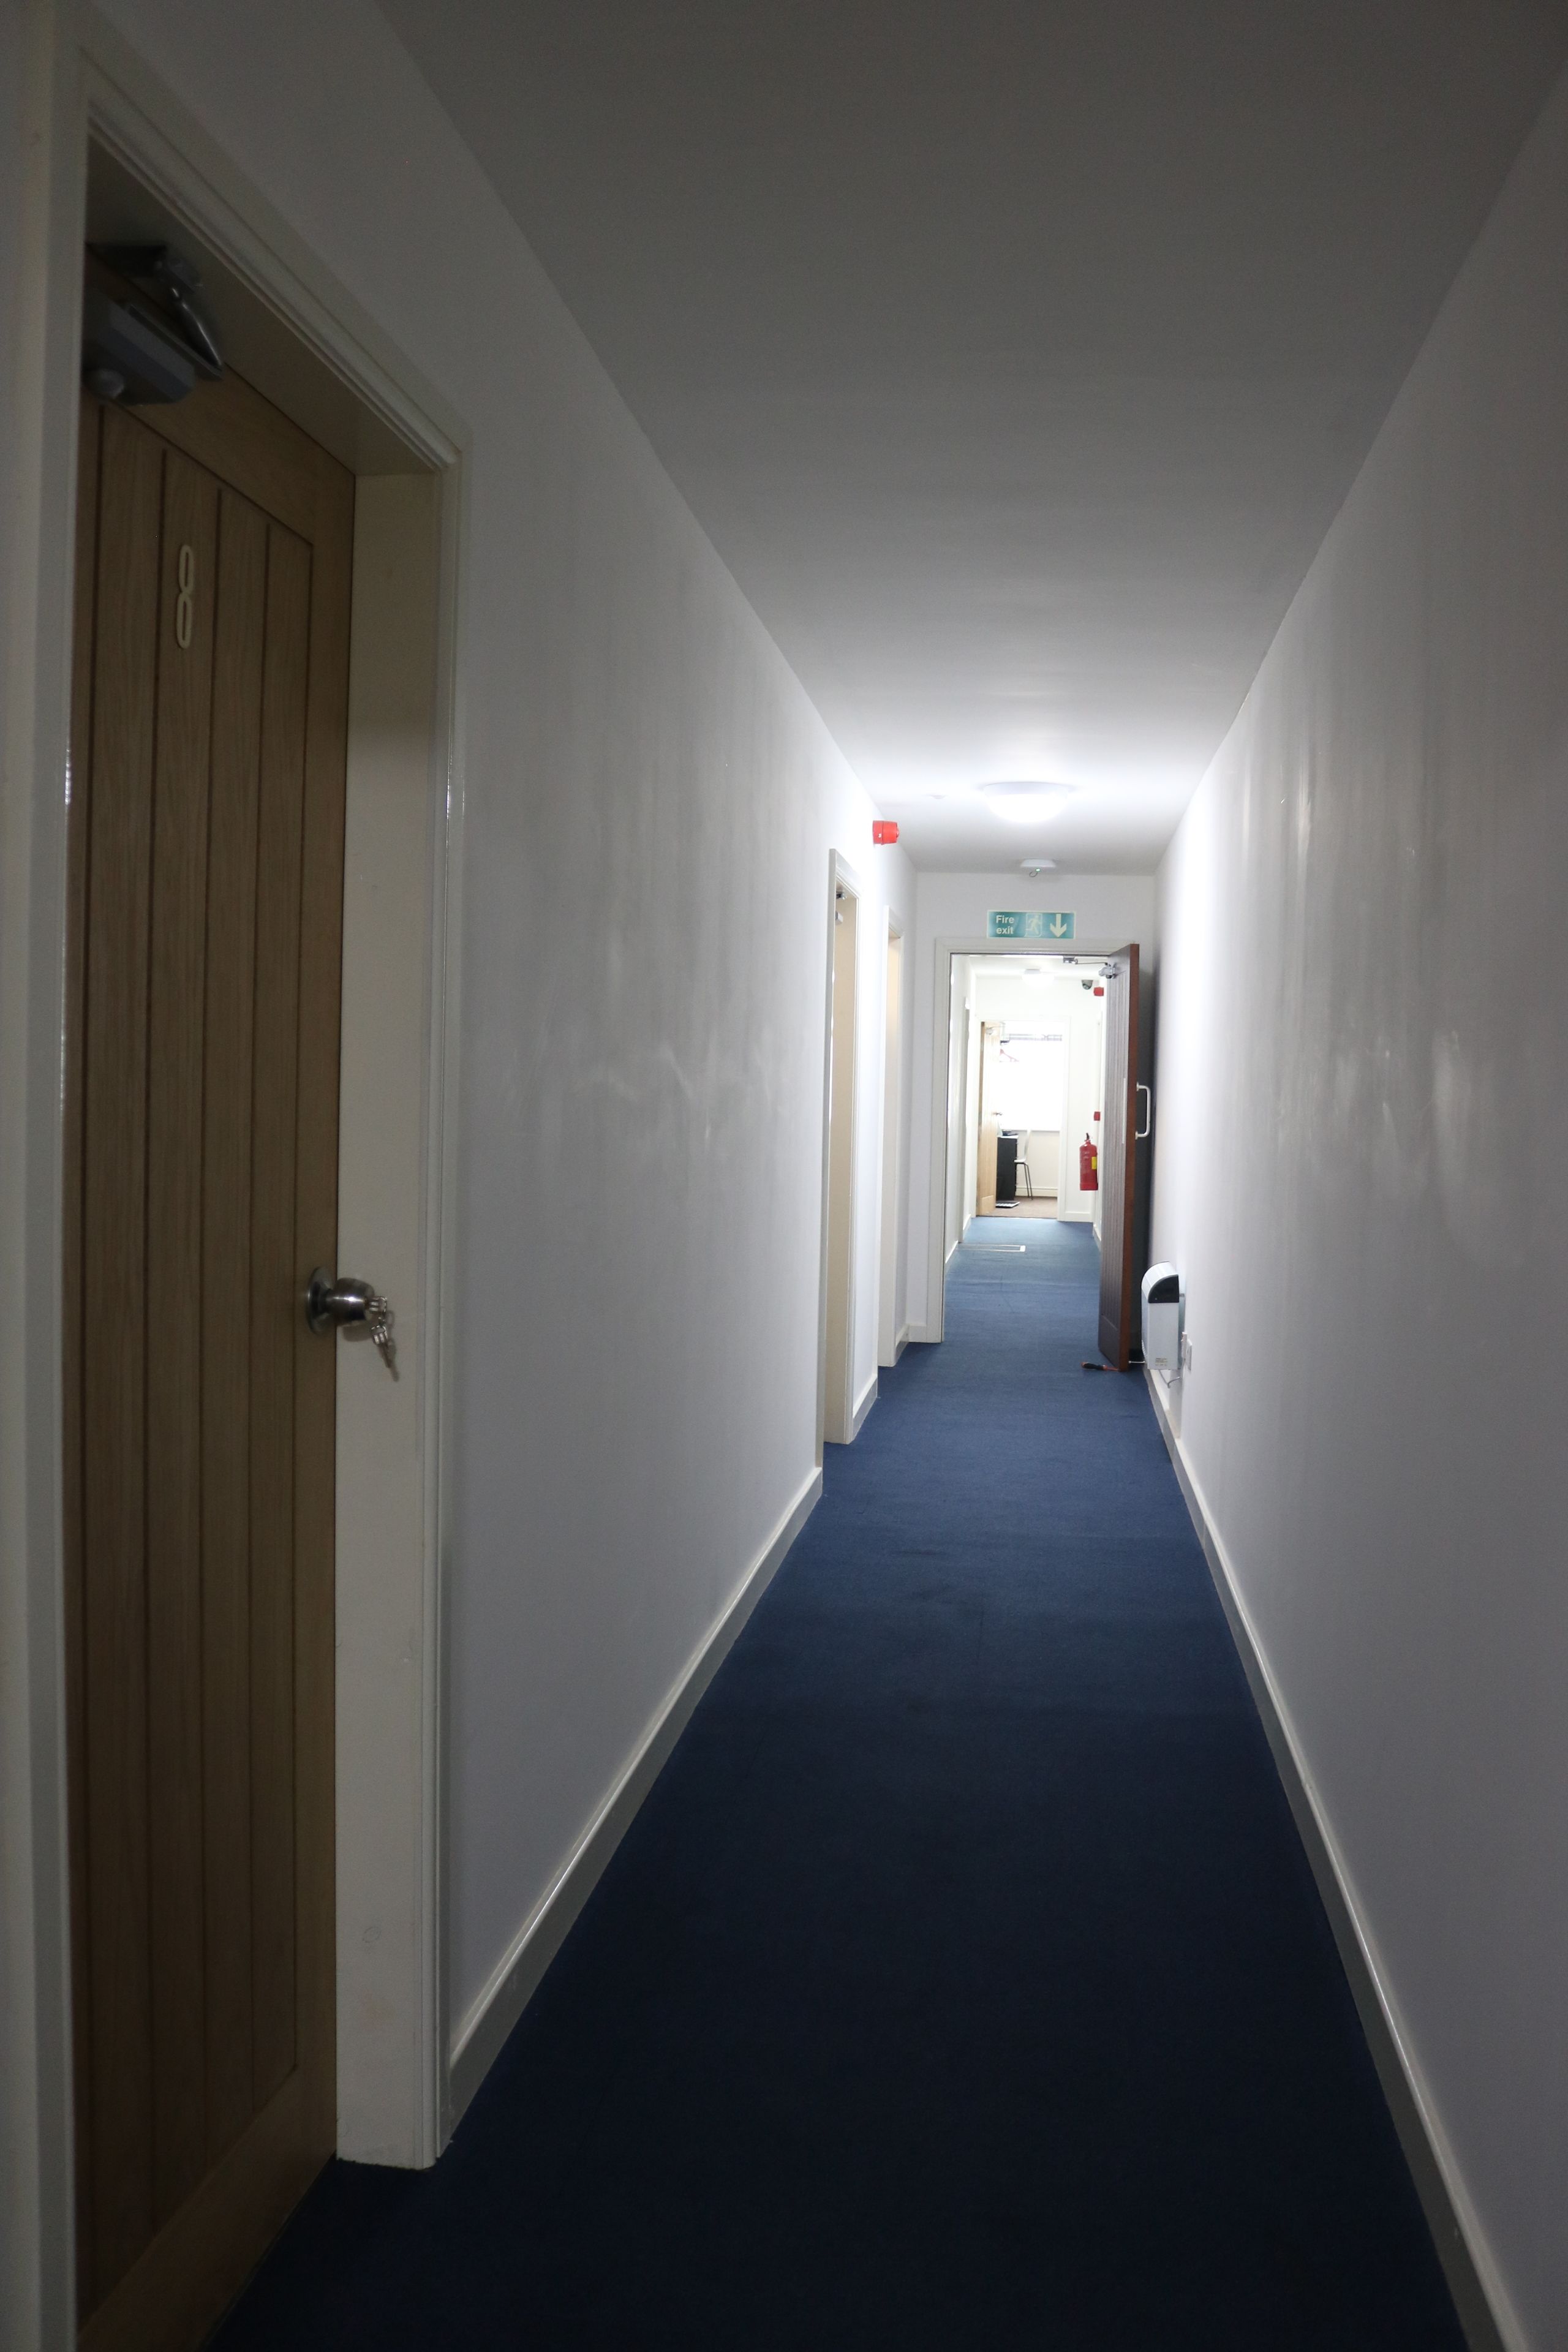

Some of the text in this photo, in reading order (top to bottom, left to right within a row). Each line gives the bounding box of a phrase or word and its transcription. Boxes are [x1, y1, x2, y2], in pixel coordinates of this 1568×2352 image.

[177, 545, 194, 649] 8
[996, 915, 1014, 924] Fire
[996, 926, 1014, 935] exit
